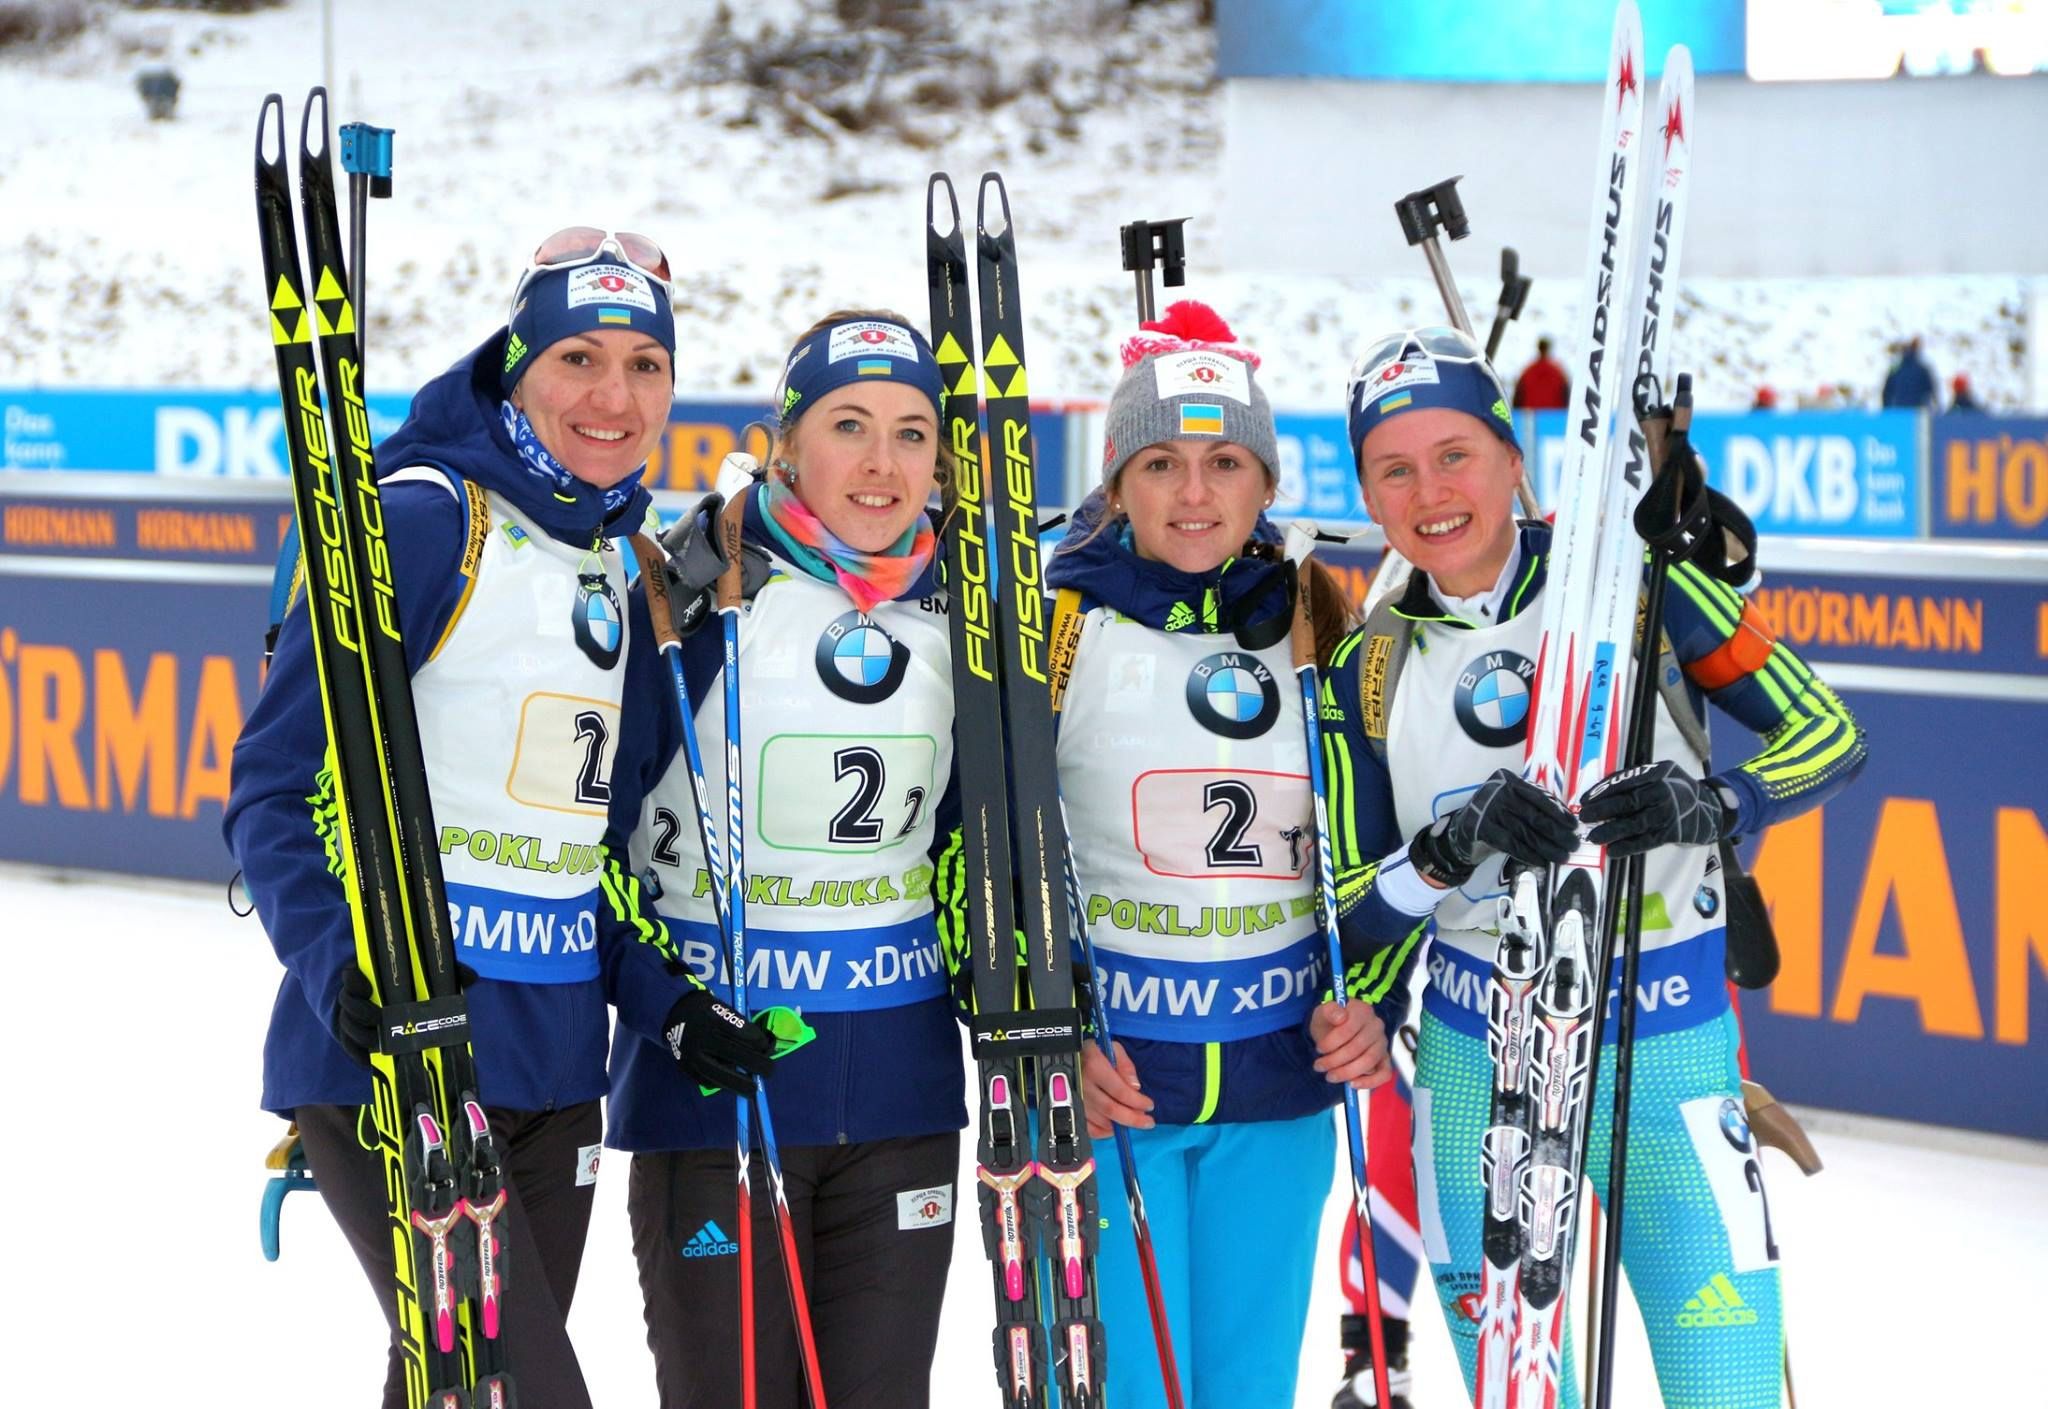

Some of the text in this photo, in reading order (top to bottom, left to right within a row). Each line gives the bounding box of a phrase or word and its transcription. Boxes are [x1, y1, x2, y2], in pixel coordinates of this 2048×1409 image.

[1581, 152, 1626, 448] MADSHUS
[154, 405, 284, 478] DK
[1725, 435, 1859, 523] DKB
[295, 366, 362, 653] FISCHER
[335, 357, 402, 643] FISCHER
[952, 416, 993, 682] FISCHER
[1003, 419, 1048, 685] FISCHER
[574, 711, 611, 805] 2
[829, 746, 885, 844] 2
[1588, 762, 1659, 800] SWIX
[652, 807, 681, 868] 2
[1203, 780, 1263, 868] 2
[1088, 894, 1286, 937] POKLJUKA
[681, 938, 947, 991] BMW xDriv
[711, 1003, 745, 1029] adidas
[681, 1239, 739, 1258] adidas
[1676, 1311, 1759, 1328] adidas
